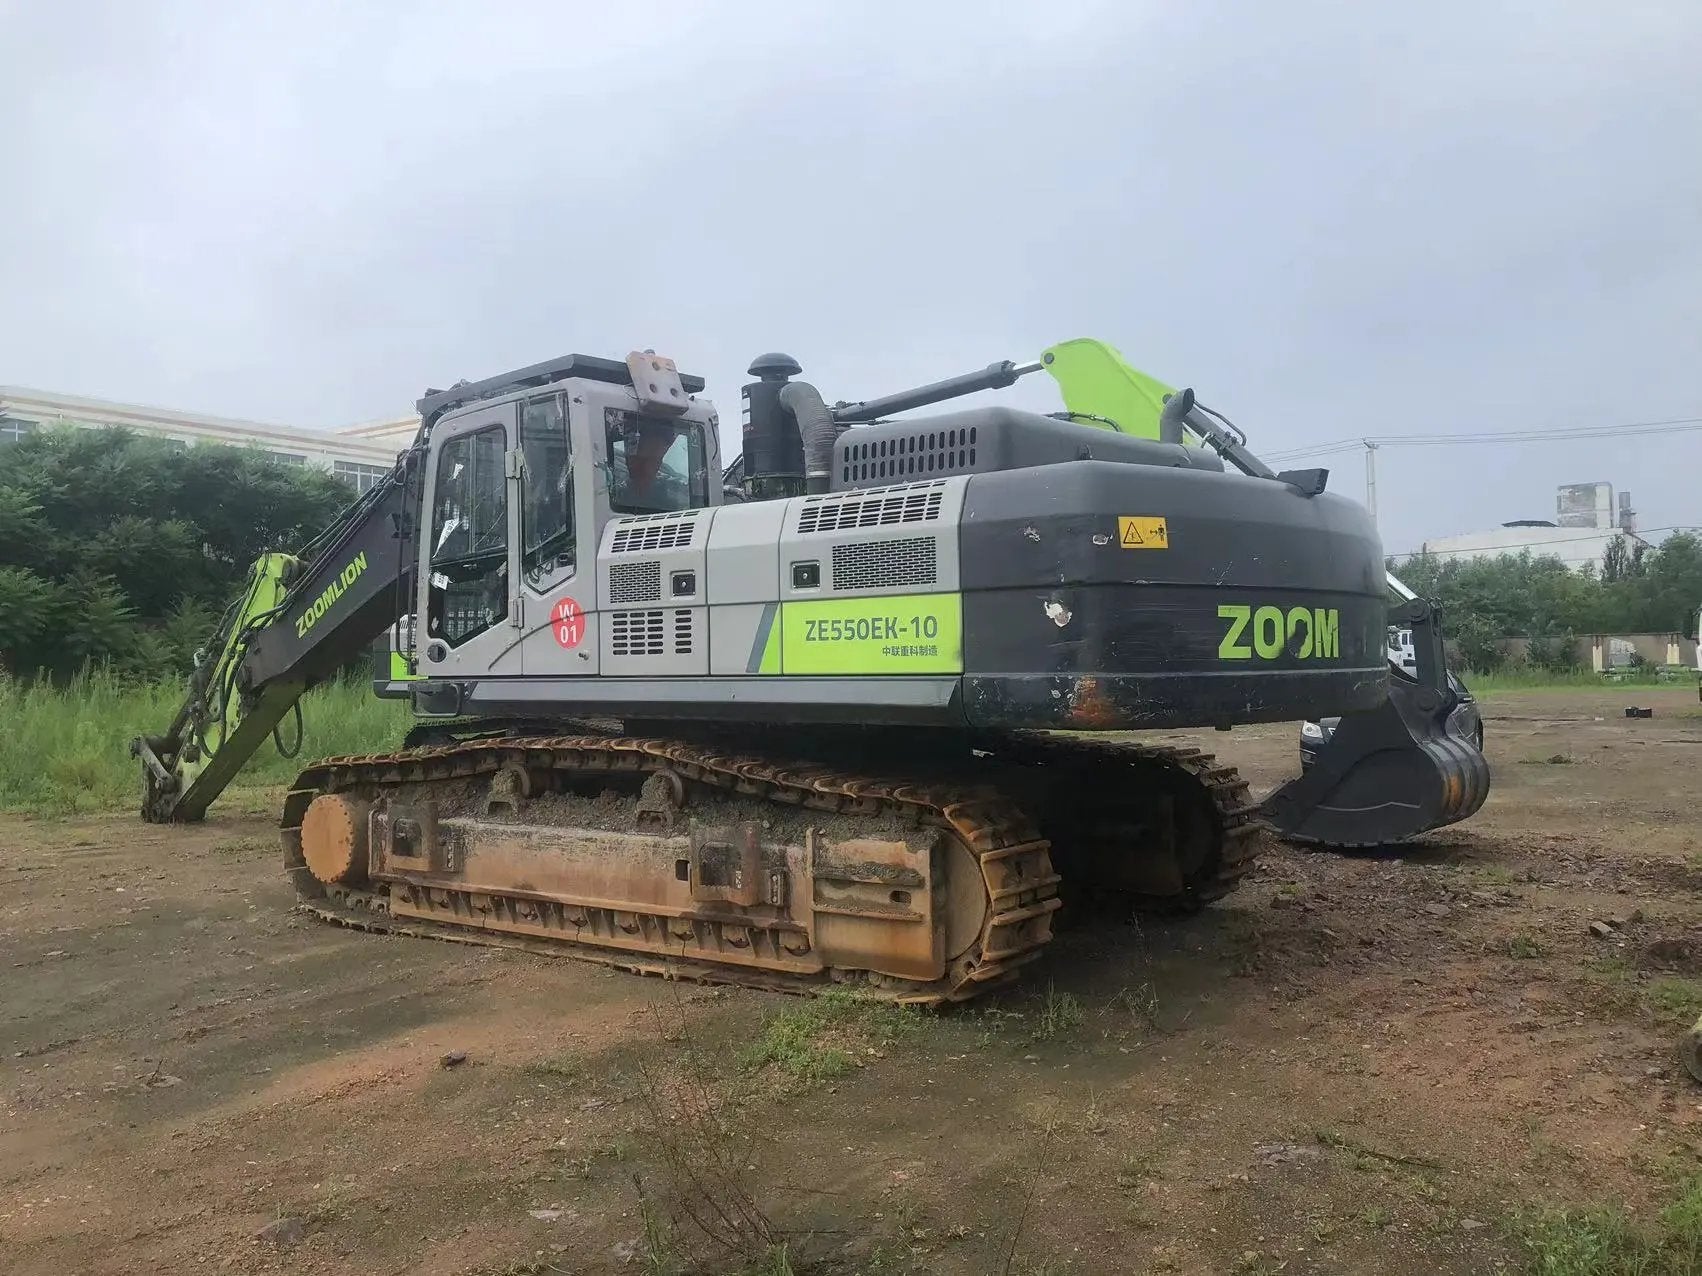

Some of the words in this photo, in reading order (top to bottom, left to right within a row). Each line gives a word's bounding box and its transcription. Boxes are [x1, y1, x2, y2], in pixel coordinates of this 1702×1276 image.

[295, 551, 368, 638] ZOOMLION
[558, 603, 575, 622] W
[560, 625, 577, 643] 01
[805, 615, 938, 641] ZE550EK-10
[1217, 605, 1339, 659] ZOOM
[882, 645, 938, 656] 中联重科制造
